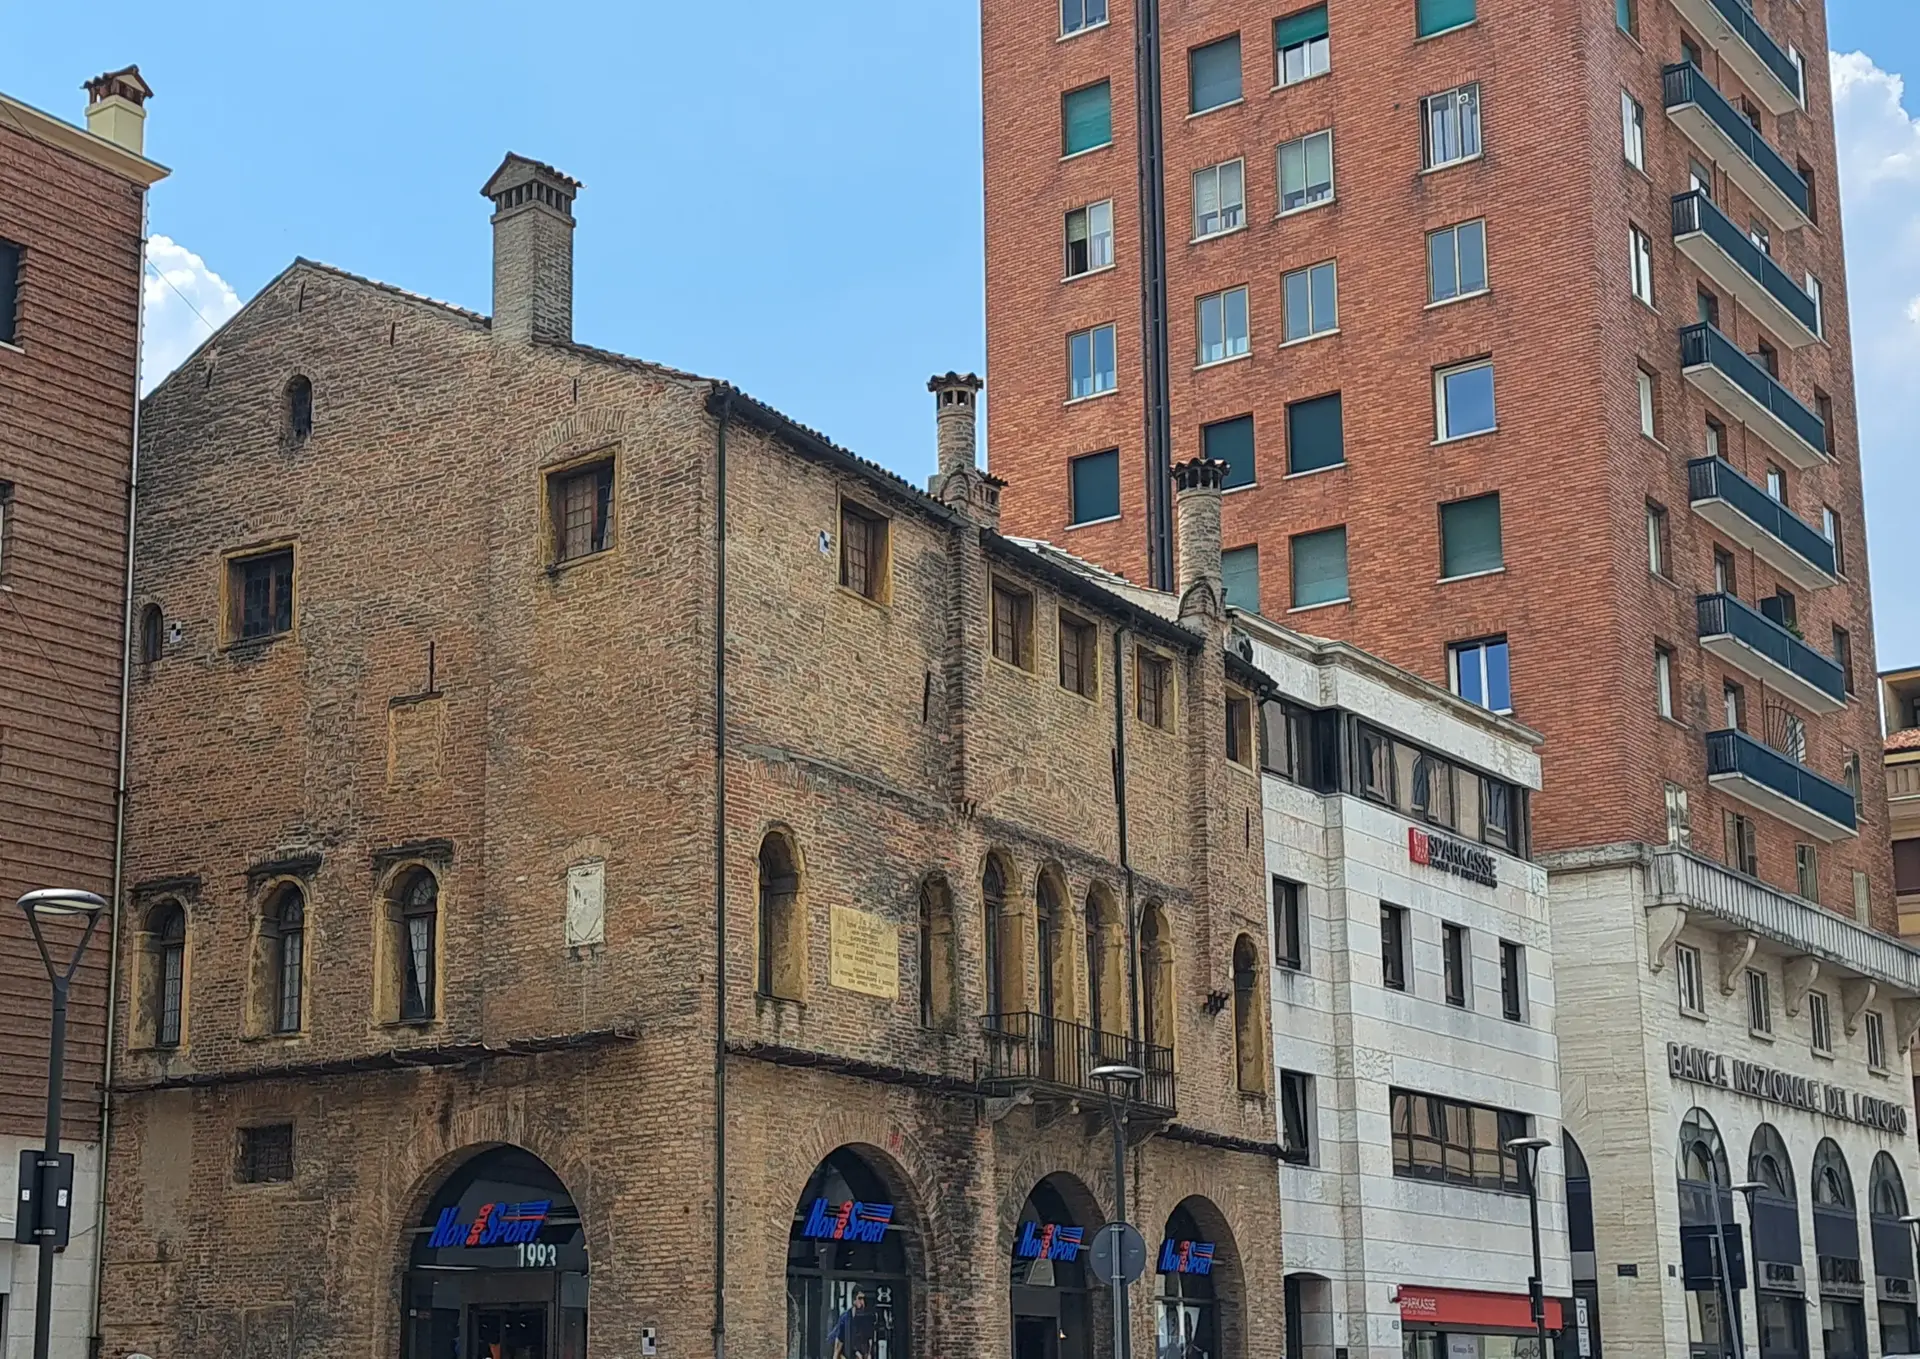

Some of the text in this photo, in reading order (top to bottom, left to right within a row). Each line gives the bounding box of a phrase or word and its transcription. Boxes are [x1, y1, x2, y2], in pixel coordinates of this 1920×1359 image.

[1428, 834, 1497, 878] SPARKASSE
[1667, 1041, 1729, 1087] BANCA
[1732, 1059, 1821, 1112] NAZIONALE
[1853, 1092, 1908, 1134] LAVORO
[517, 1242, 556, 1268] 1993
